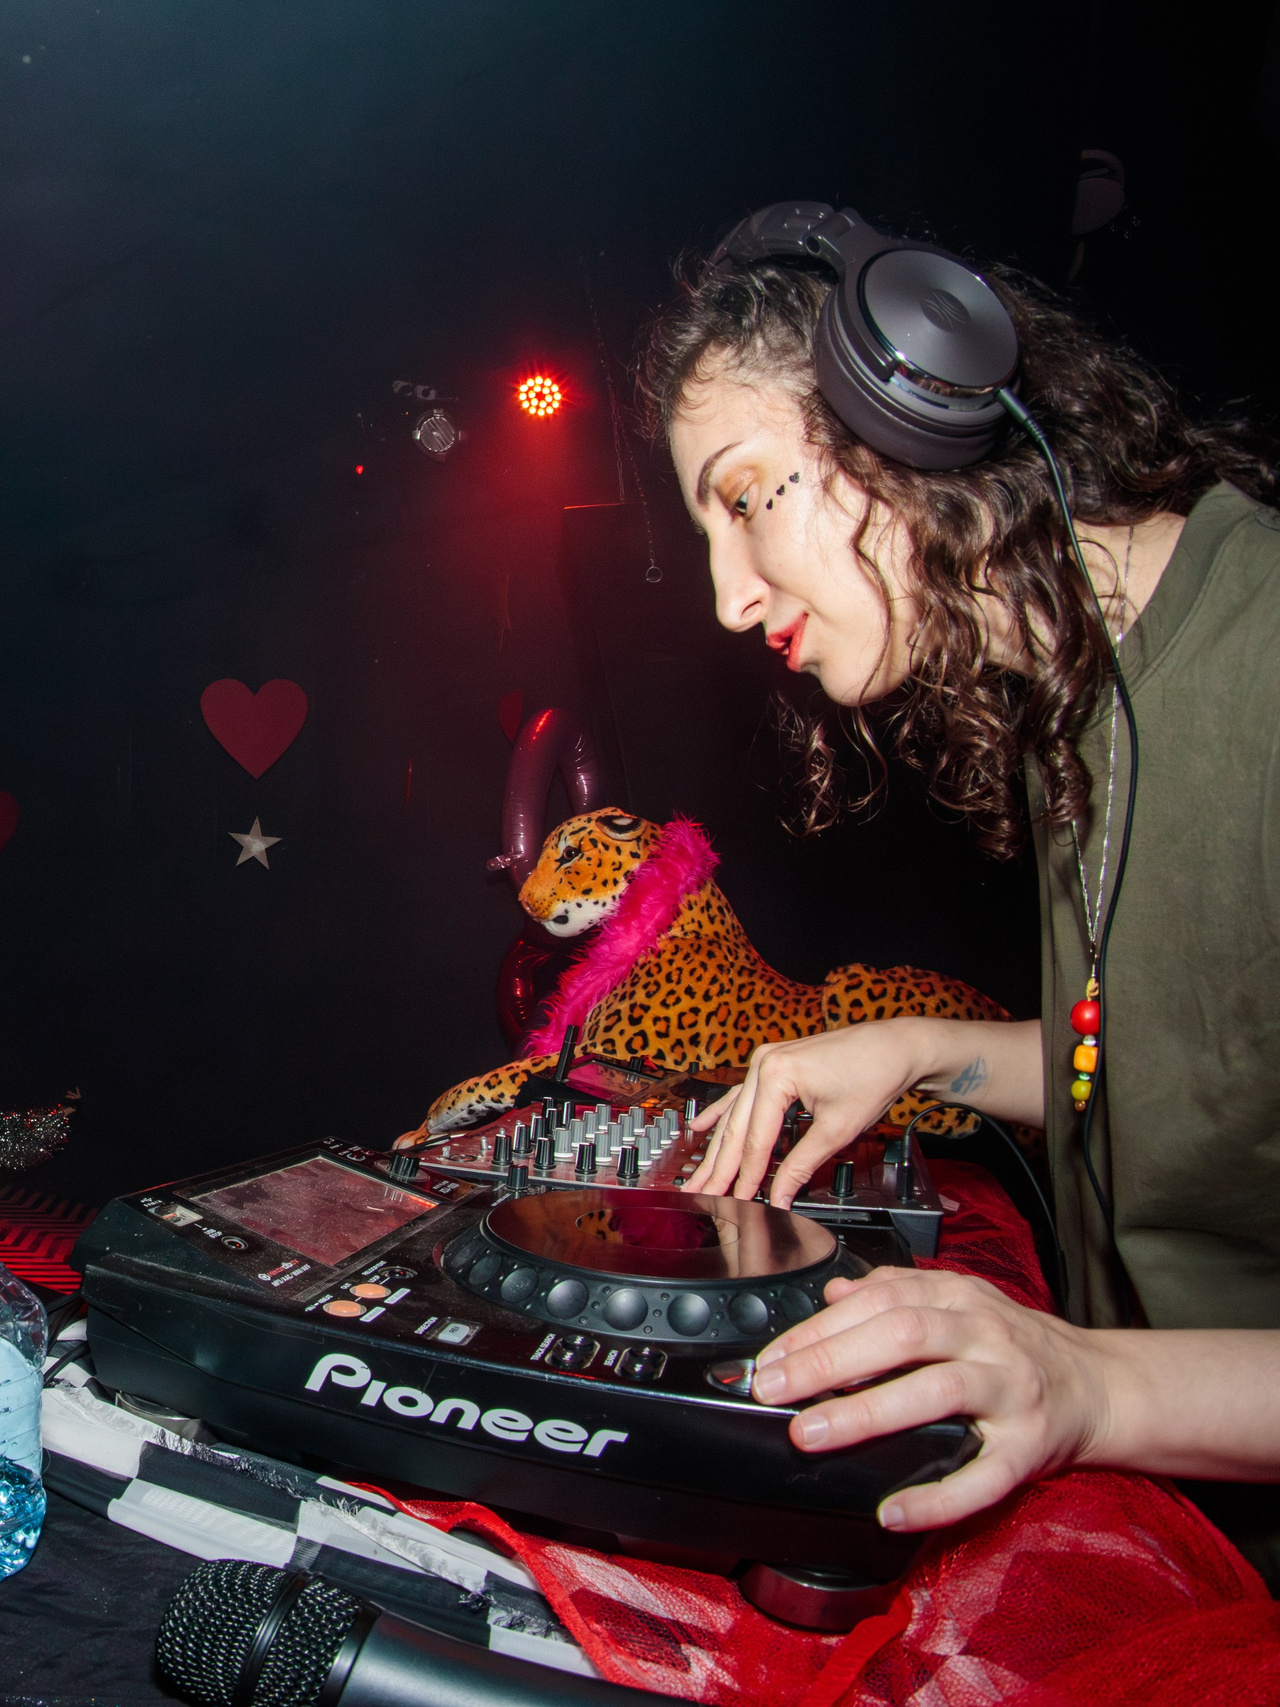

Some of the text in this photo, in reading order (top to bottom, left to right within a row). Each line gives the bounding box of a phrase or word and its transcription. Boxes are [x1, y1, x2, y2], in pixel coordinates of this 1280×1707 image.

[530, 1333, 556, 1361] TRACK SEARCH
[603, 1349, 619, 1366] SEARCH
[304, 1353, 630, 1457] Pioneer
